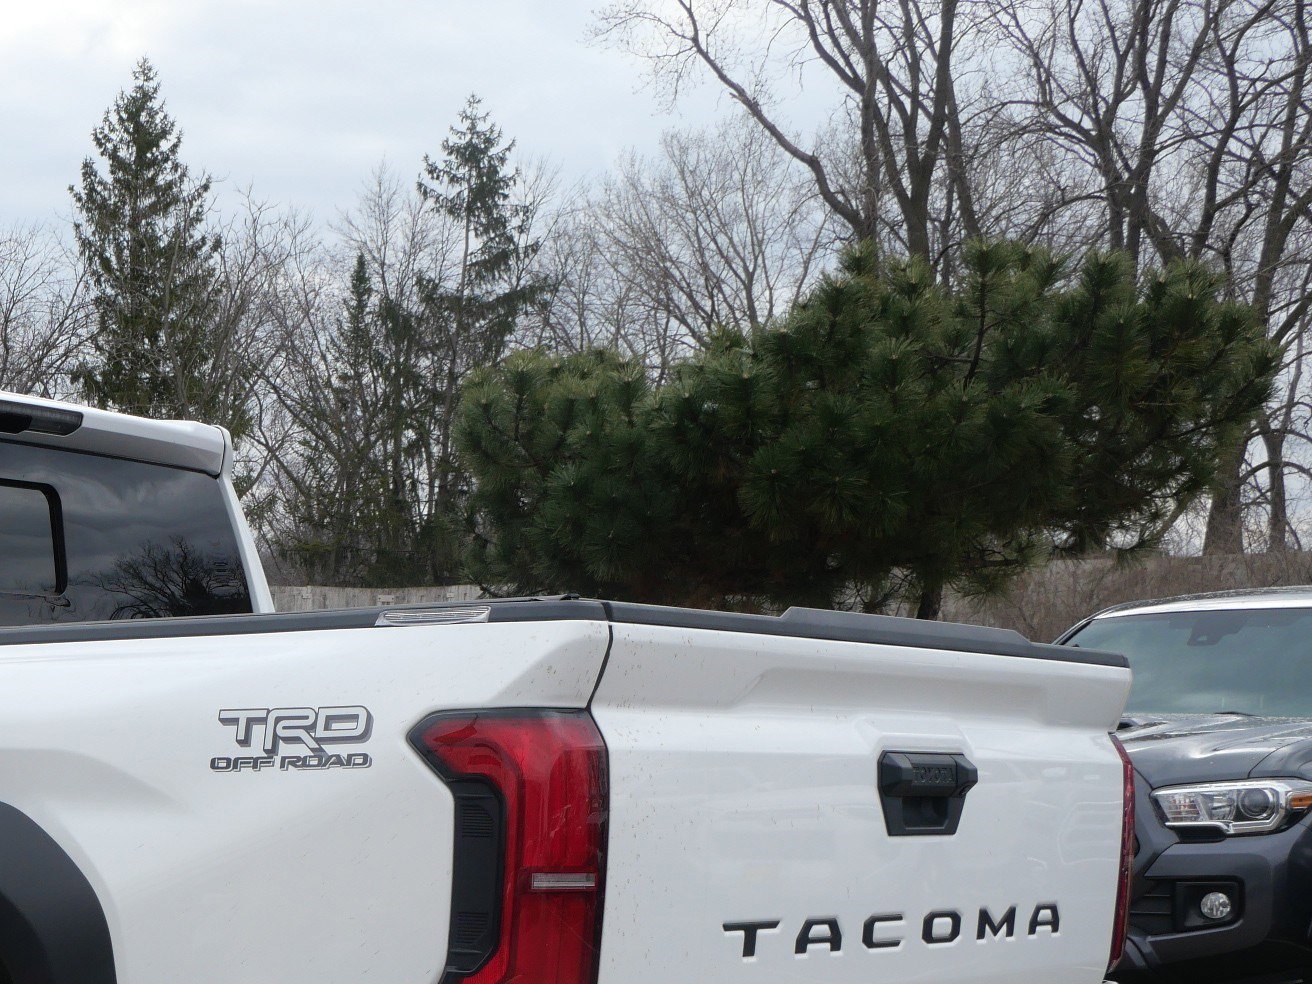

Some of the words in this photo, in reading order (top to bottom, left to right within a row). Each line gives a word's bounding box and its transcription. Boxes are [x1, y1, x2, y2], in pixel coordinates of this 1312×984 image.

[218, 705, 374, 757] TRD
[210, 756, 276, 773] OFF
[280, 752, 373, 772] ROAD
[722, 902, 1061, 959] TACOMA
